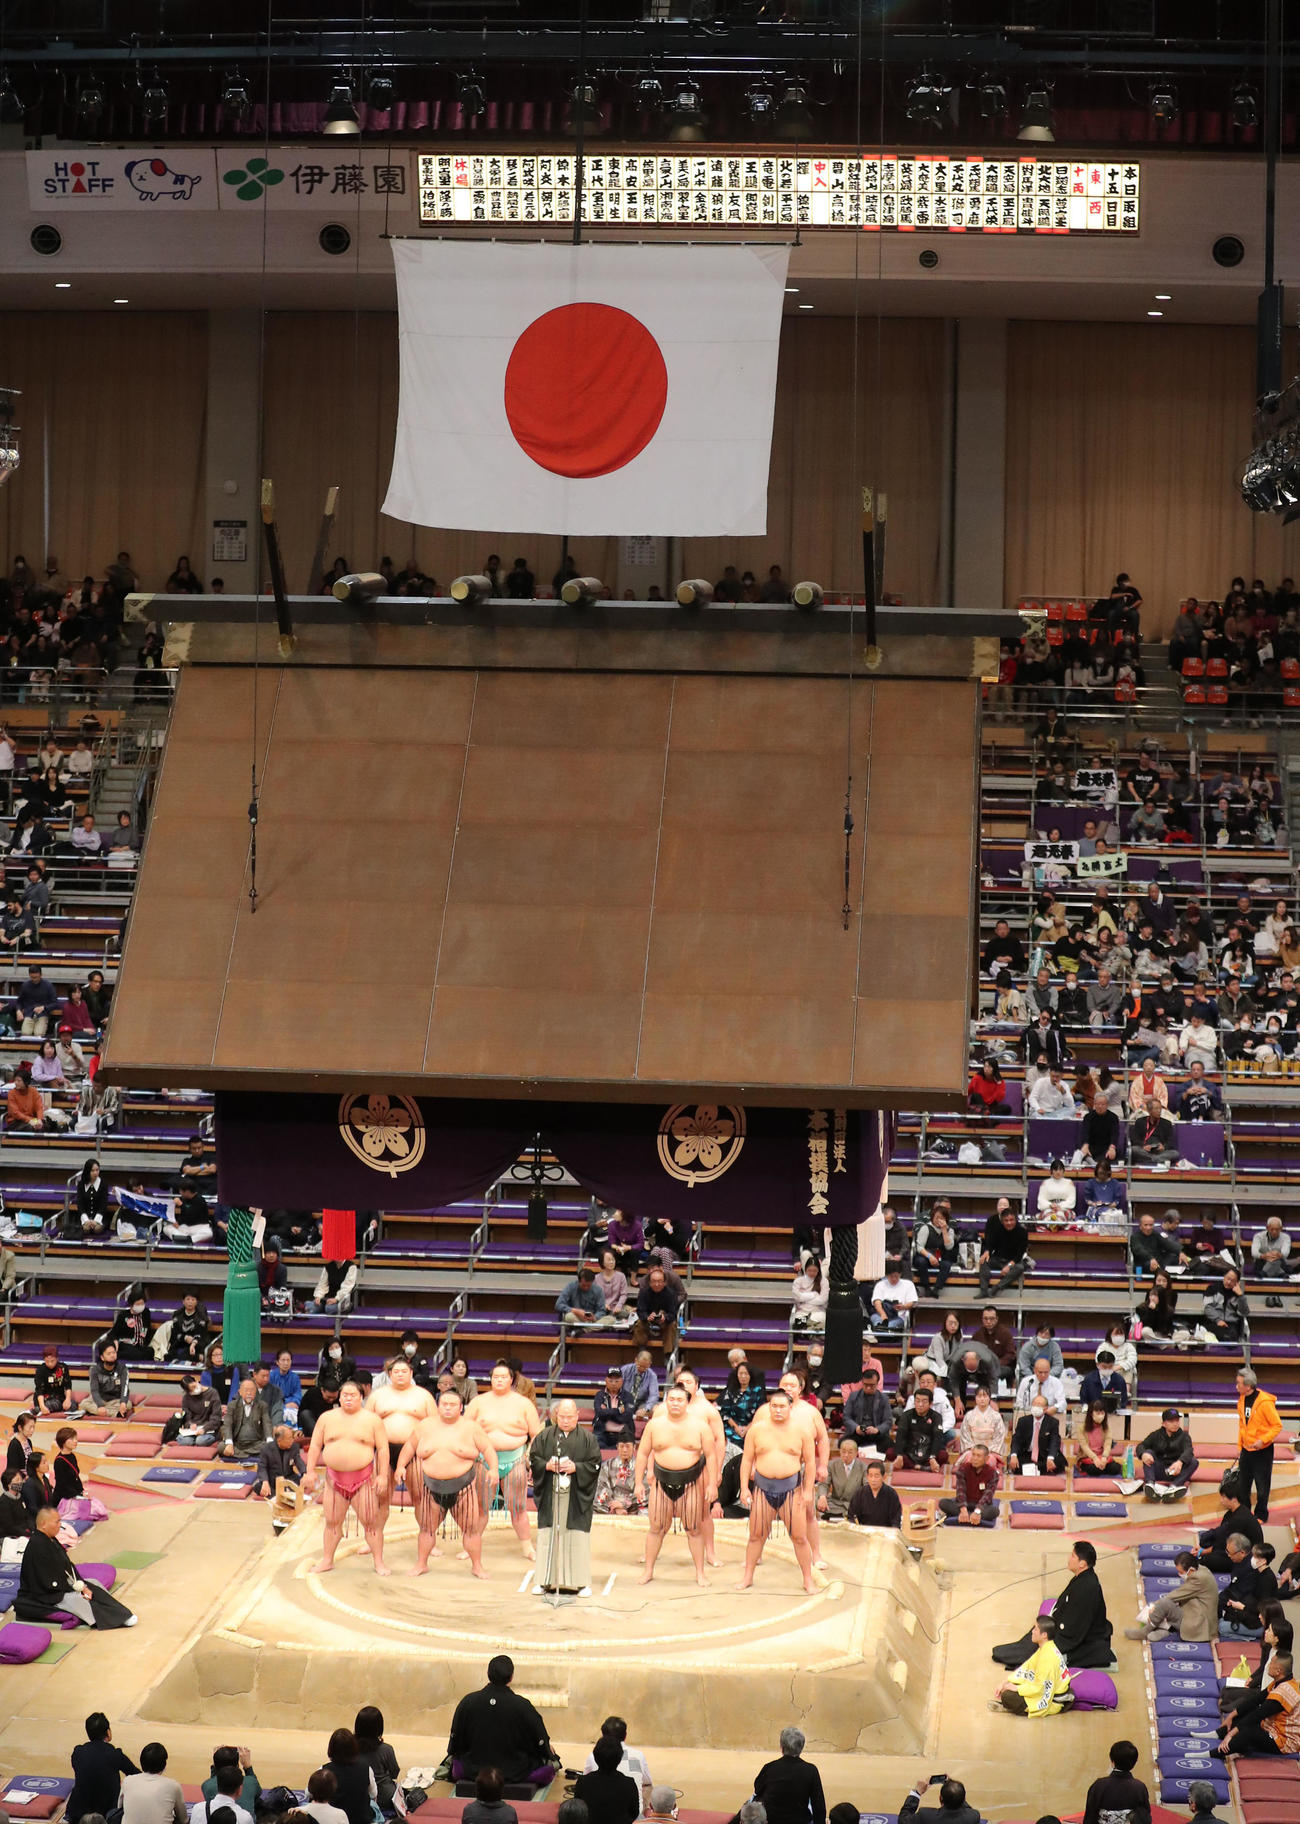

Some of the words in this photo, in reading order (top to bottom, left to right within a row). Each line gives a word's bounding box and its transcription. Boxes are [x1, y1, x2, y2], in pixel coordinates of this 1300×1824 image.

[55, 162, 100, 177] HOT
[290, 163, 406, 196] 伊藤園
[455, 159, 467, 186] 休場
[541, 159, 552, 185] 阿炎
[592, 159, 603, 186] 正代
[694, 162, 705, 186] 一山本
[711, 160, 722, 187] 遠藤
[762, 160, 774, 189] 竜電
[780, 160, 792, 188] 北の若
[815, 162, 826, 187] 中入
[935, 163, 946, 192] 大の里
[952, 164, 964, 192] 千代丸
[1074, 167, 1083, 193] 十両
[1092, 169, 1100, 184] 東
[44, 178, 114, 193] STAFF
[524, 191, 535, 219] 若元春
[609, 192, 620, 218] 明生
[712, 193, 723, 220] 狼雅
[729, 193, 741, 220] 友風
[781, 194, 792, 222] 平戸海
[1090, 202, 1101, 214] 西
